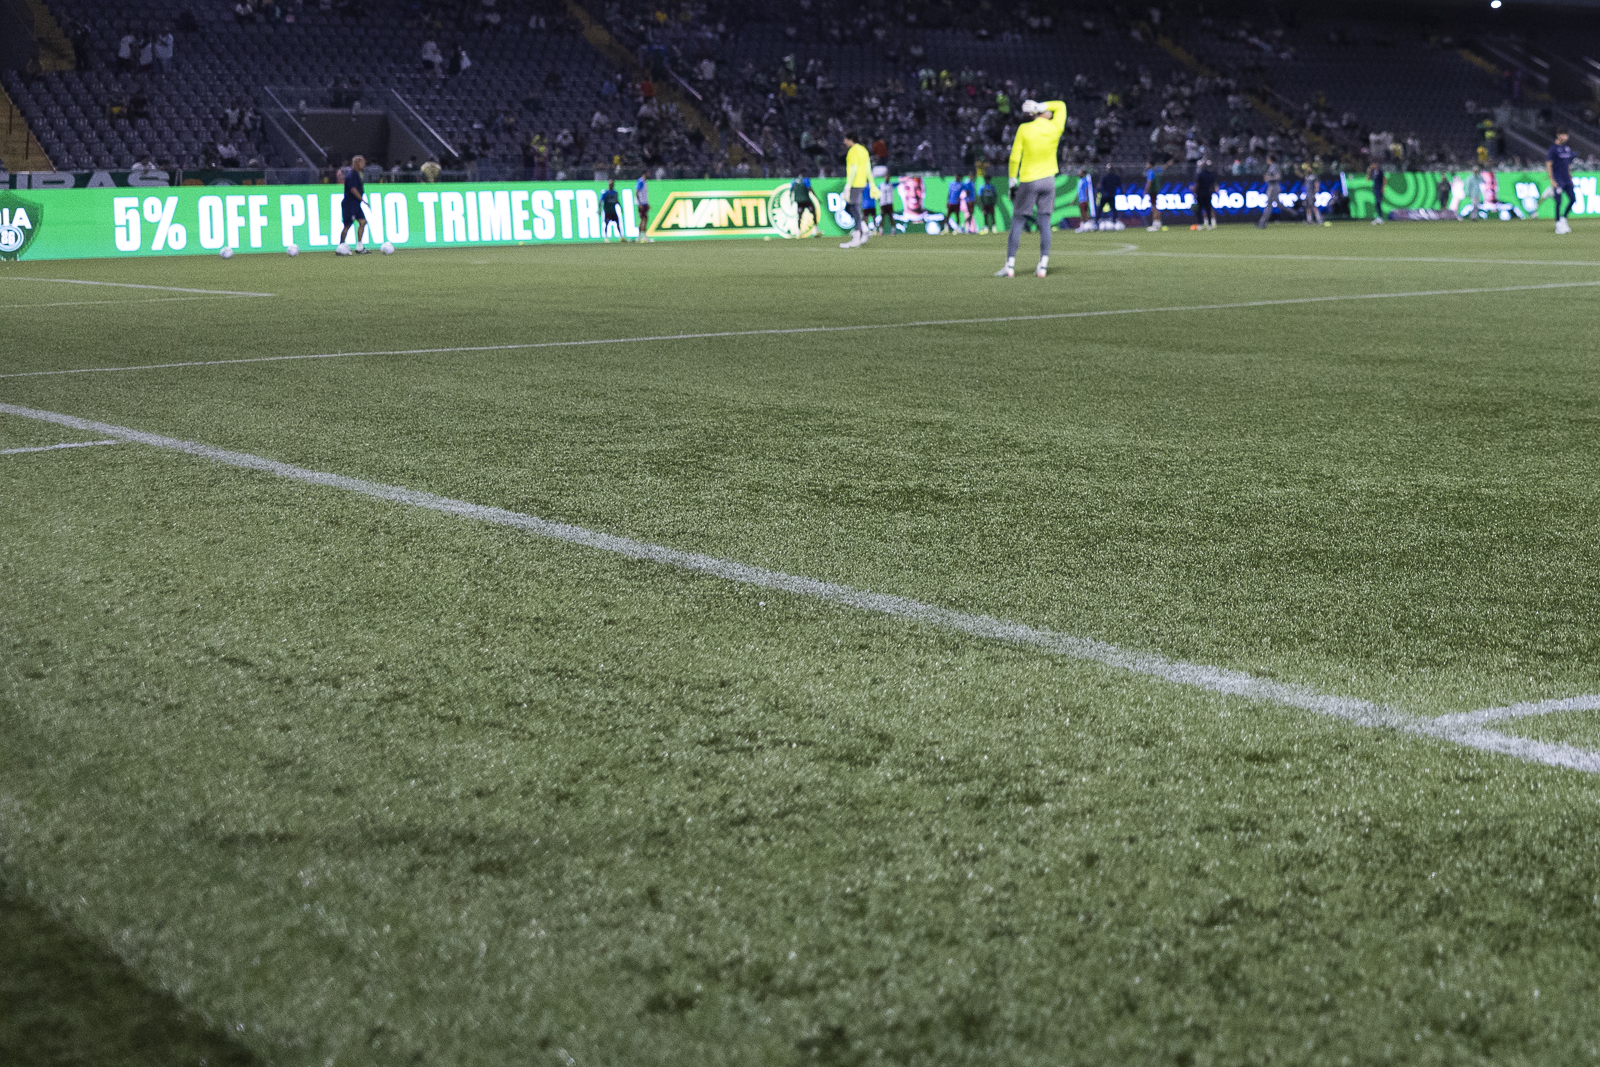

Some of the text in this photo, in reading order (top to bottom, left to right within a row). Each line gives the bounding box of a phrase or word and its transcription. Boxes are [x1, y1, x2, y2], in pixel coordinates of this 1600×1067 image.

[0, 207, 32, 230] IA
[113, 196, 187, 251] 5%
[198, 194, 268, 250] OFF
[661, 198, 768, 229] AVANTI
